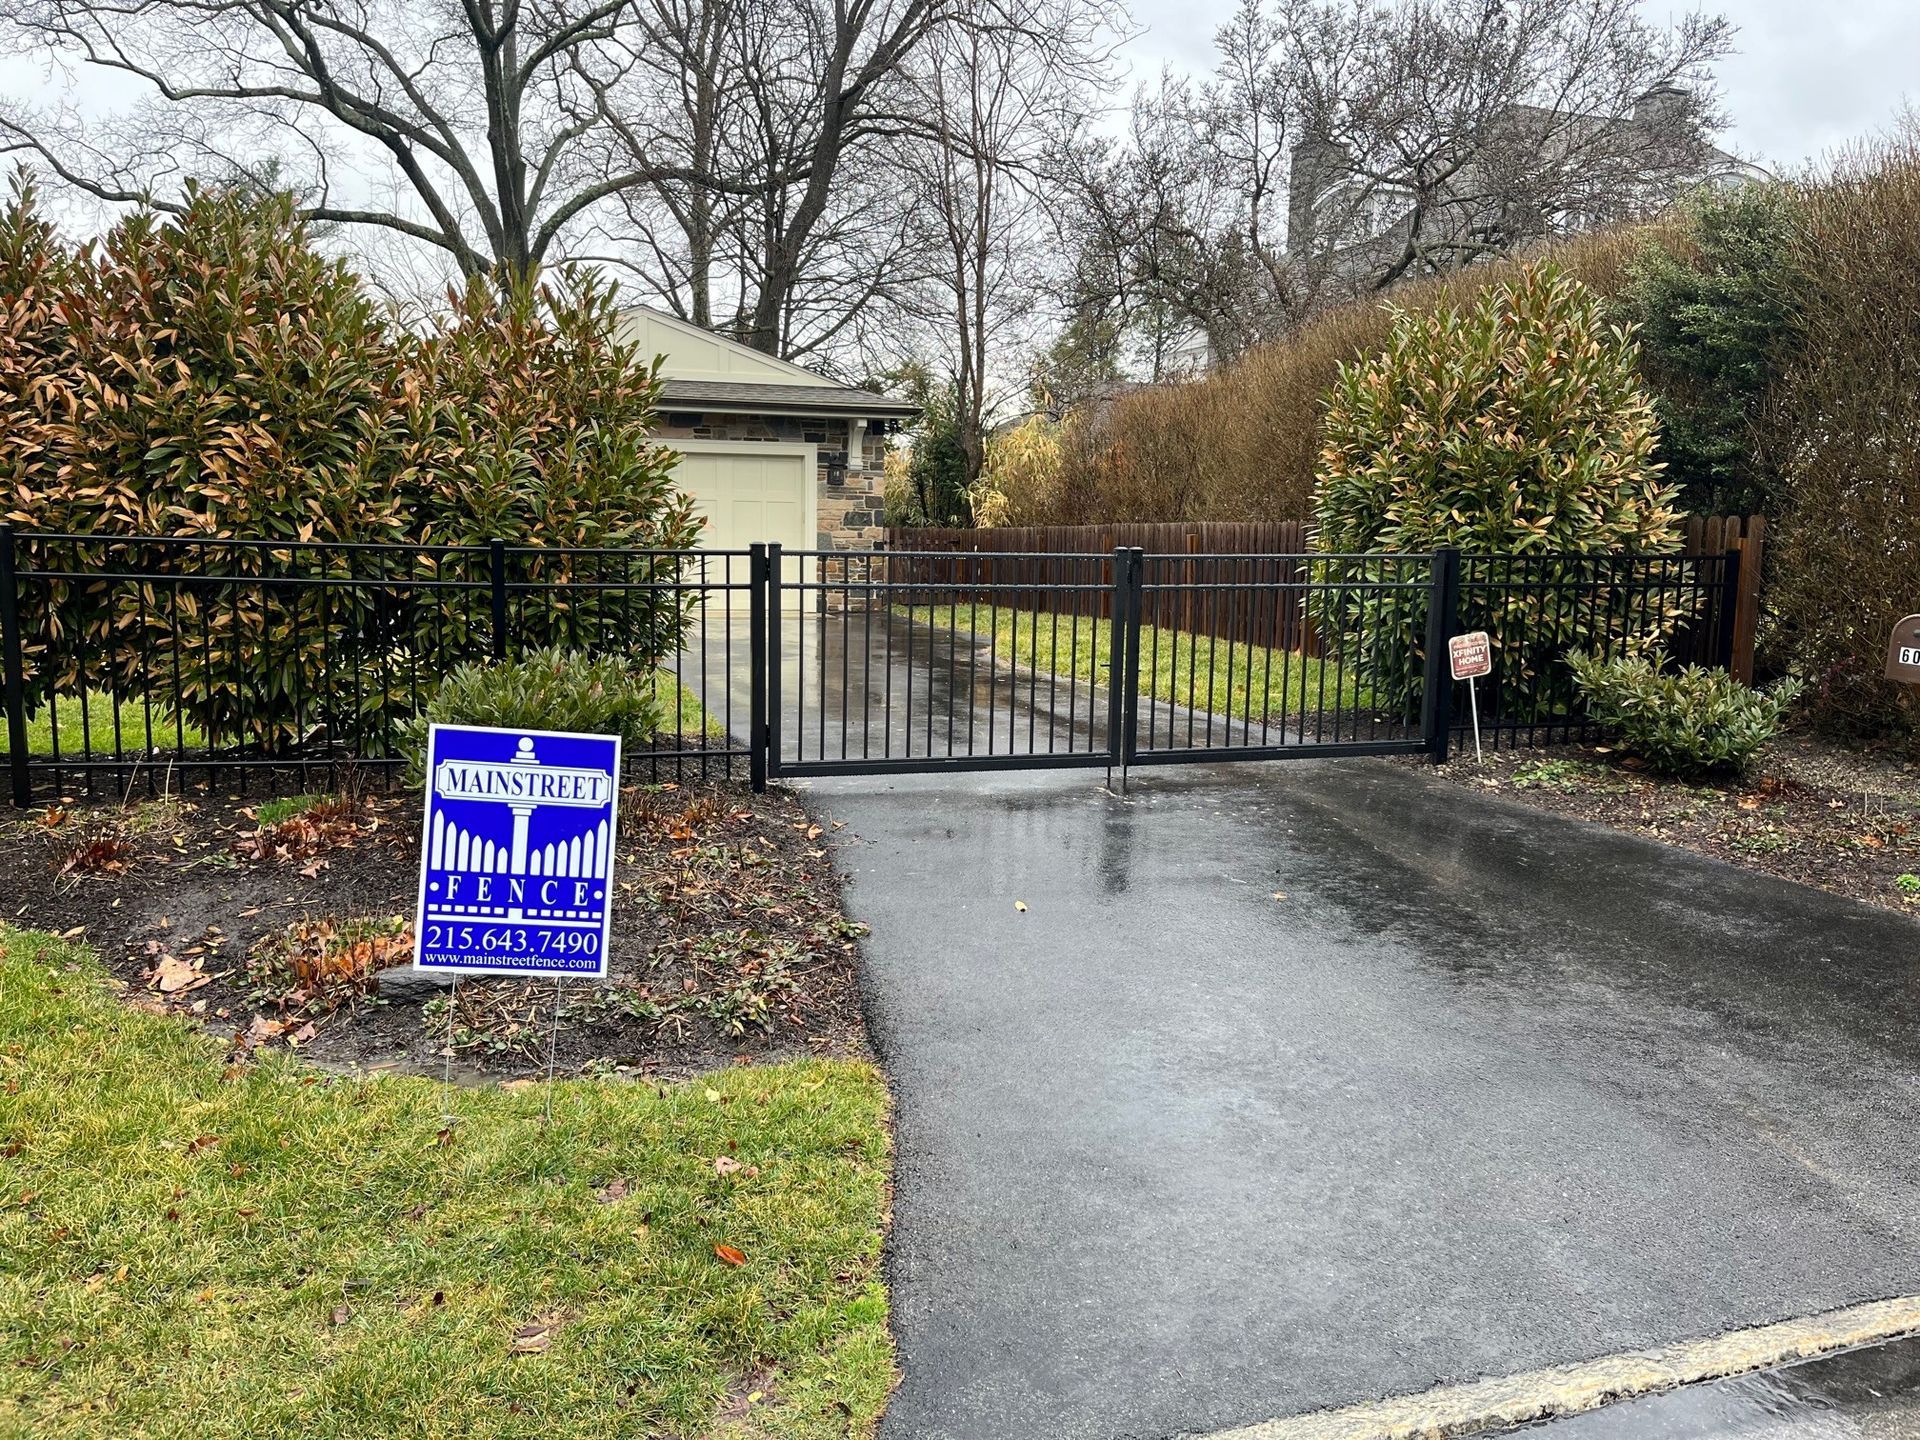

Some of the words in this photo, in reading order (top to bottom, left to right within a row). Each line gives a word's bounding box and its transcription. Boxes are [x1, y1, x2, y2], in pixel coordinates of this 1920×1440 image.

[1453, 645, 1486, 658] XFINITY
[1458, 654, 1484, 666] HOME
[446, 767, 602, 800] MAINSTREET
[446, 875, 589, 906] FENCE
[426, 926, 598, 955] 215.643.7490
[425, 952, 596, 969] www.mainstreetfence.com
